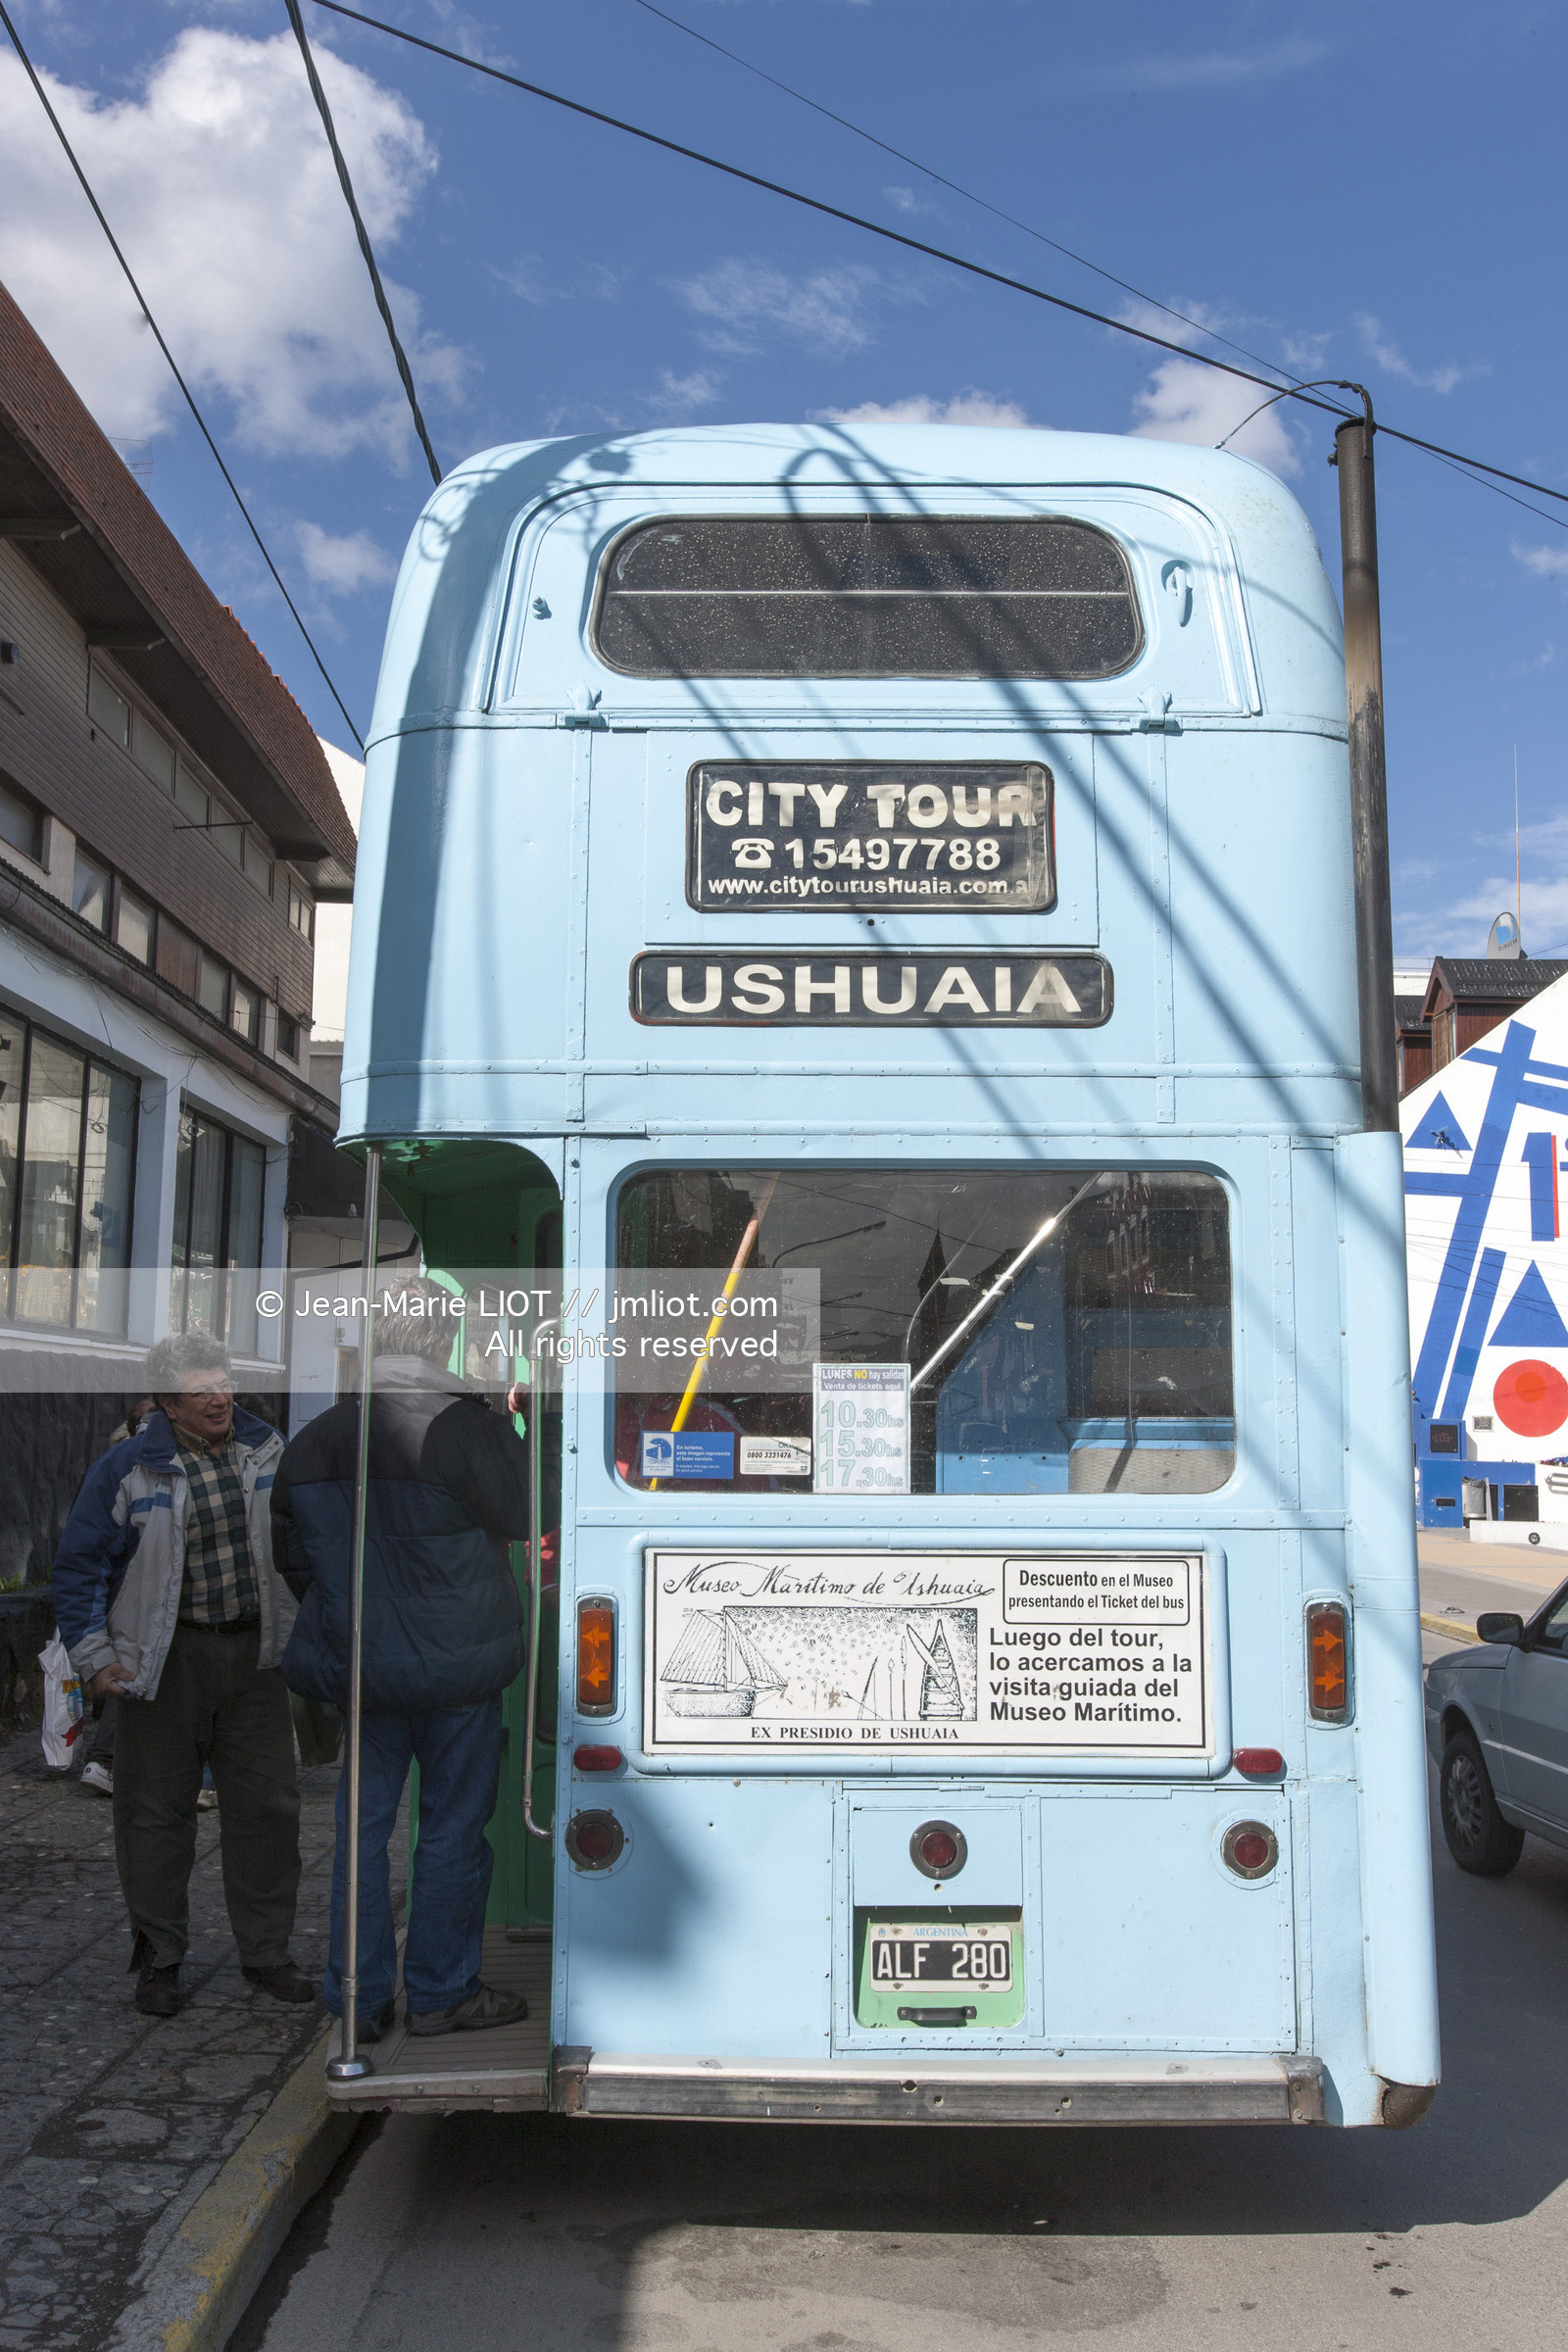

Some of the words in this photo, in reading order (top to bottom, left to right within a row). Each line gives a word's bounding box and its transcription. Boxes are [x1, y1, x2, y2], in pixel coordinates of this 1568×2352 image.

[706, 780, 850, 828] CITY
[867, 783, 1037, 829] TOUR
[785, 838, 1002, 871] 15497788
[709, 875, 1030, 897] www.citytourushuaia.com.a
[666, 963, 1082, 1014] USHUAIA
[822, 1369, 853, 1380] LUNES
[854, 1369, 868, 1380] NO
[868, 1369, 881, 1382] hay
[882, 1369, 906, 1380] salidas
[663, 1562, 742, 1594] Museo
[862, 1571, 886, 1594] de
[893, 1570, 996, 1596] Ushuaia
[1019, 1569, 1098, 1587] Descuento
[1101, 1576, 1116, 1587] en
[1119, 1574, 1130, 1587] el
[1133, 1573, 1173, 1588] Museo
[1008, 1594, 1085, 1610] presentando
[1088, 1594, 1099, 1608] el
[1102, 1594, 1139, 1608] Ticket
[1142, 1594, 1159, 1609] del
[1162, 1595, 1185, 1609] bus
[990, 1627, 1061, 1650] Luego
[1069, 1628, 1102, 1646] del
[1110, 1629, 1164, 1650] tour,
[990, 1652, 1010, 1670] lo
[1017, 1655, 1145, 1672] acercamos
[1152, 1657, 1165, 1672] a
[1172, 1653, 1193, 1672] la
[989, 1677, 1052, 1695] visita
[1058, 1678, 1137, 1700] guiada
[1144, 1678, 1179, 1697] del
[990, 1701, 1066, 1721] Museo
[1074, 1701, 1182, 1723] Marítimo.
[751, 1727, 771, 1739] EX
[780, 1727, 853, 1739] PRESIDIO
[860, 1728, 881, 1740] DE
[890, 1728, 959, 1740] USHUAIA
[912, 1927, 969, 1937] ARGENTINA
[876, 1942, 931, 1979] ALF
[951, 1942, 1006, 1979] 280
